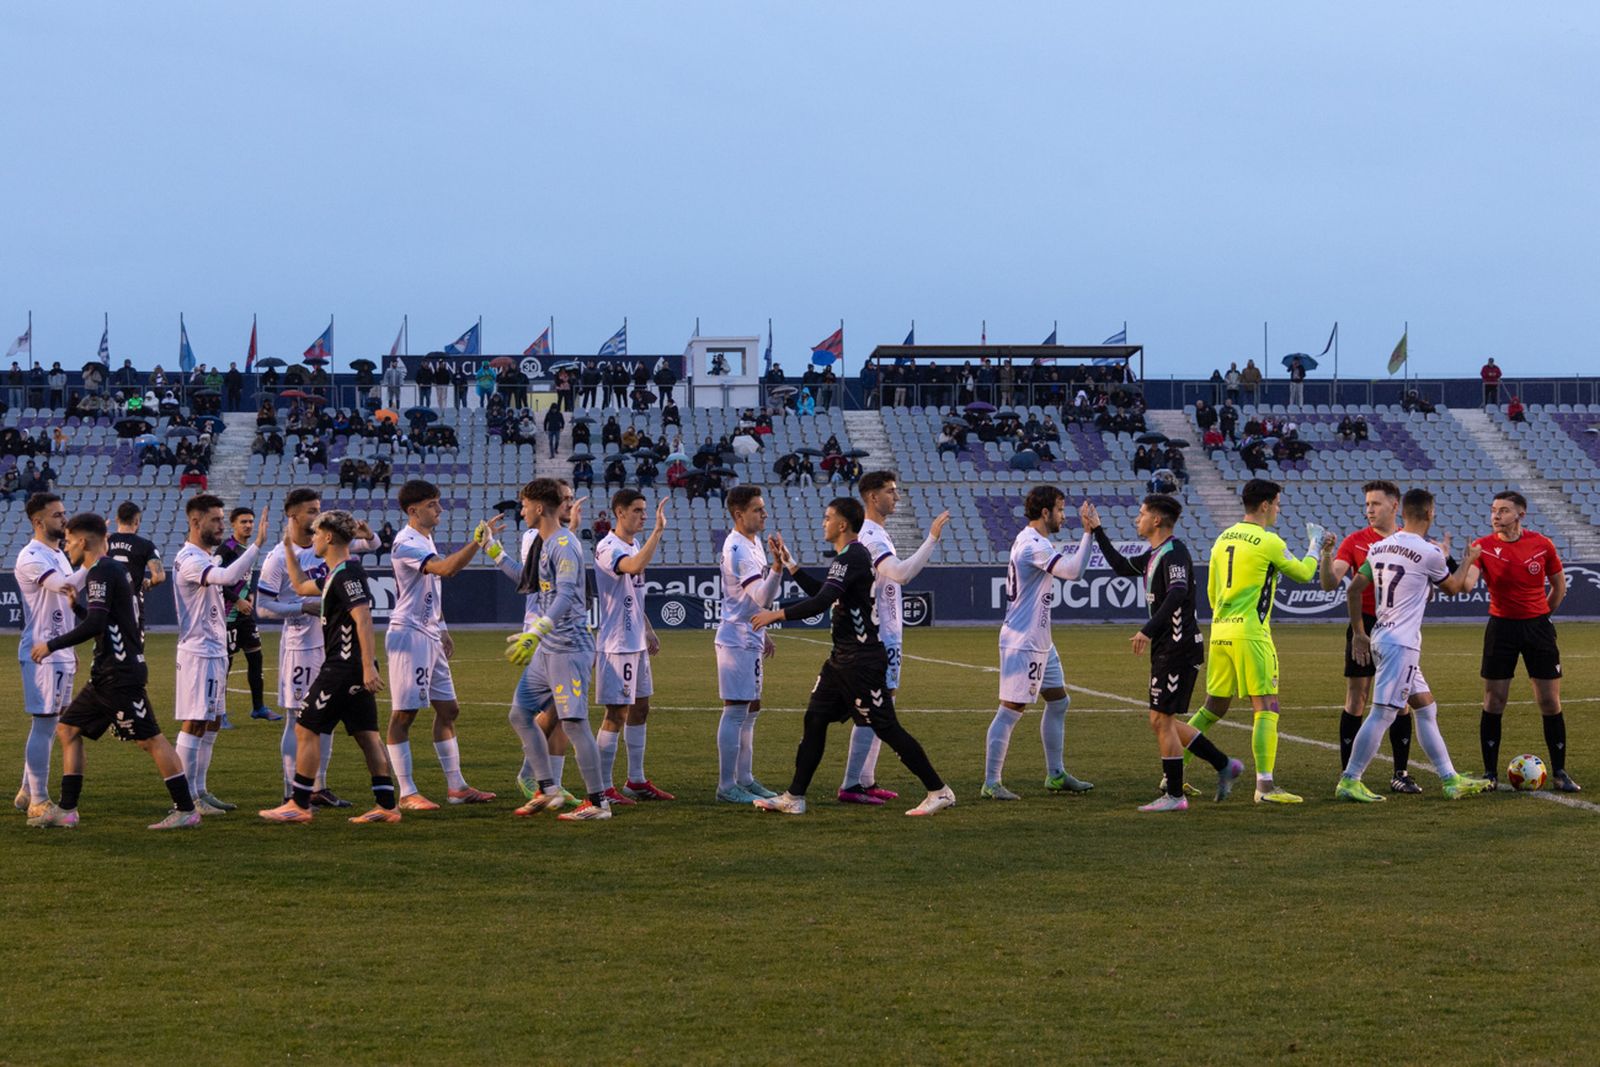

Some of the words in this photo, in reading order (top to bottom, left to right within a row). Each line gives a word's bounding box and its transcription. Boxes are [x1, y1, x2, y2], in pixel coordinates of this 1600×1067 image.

[523, 361, 537, 372] 30
[1388, 545, 1422, 563] MOYANO
[1225, 545, 1235, 588] 1
[1375, 562, 1405, 608] 17
[56, 670, 64, 690] 7
[293, 666, 311, 686] 21
[623, 663, 632, 681] 6
[207, 678, 218, 699] 11
